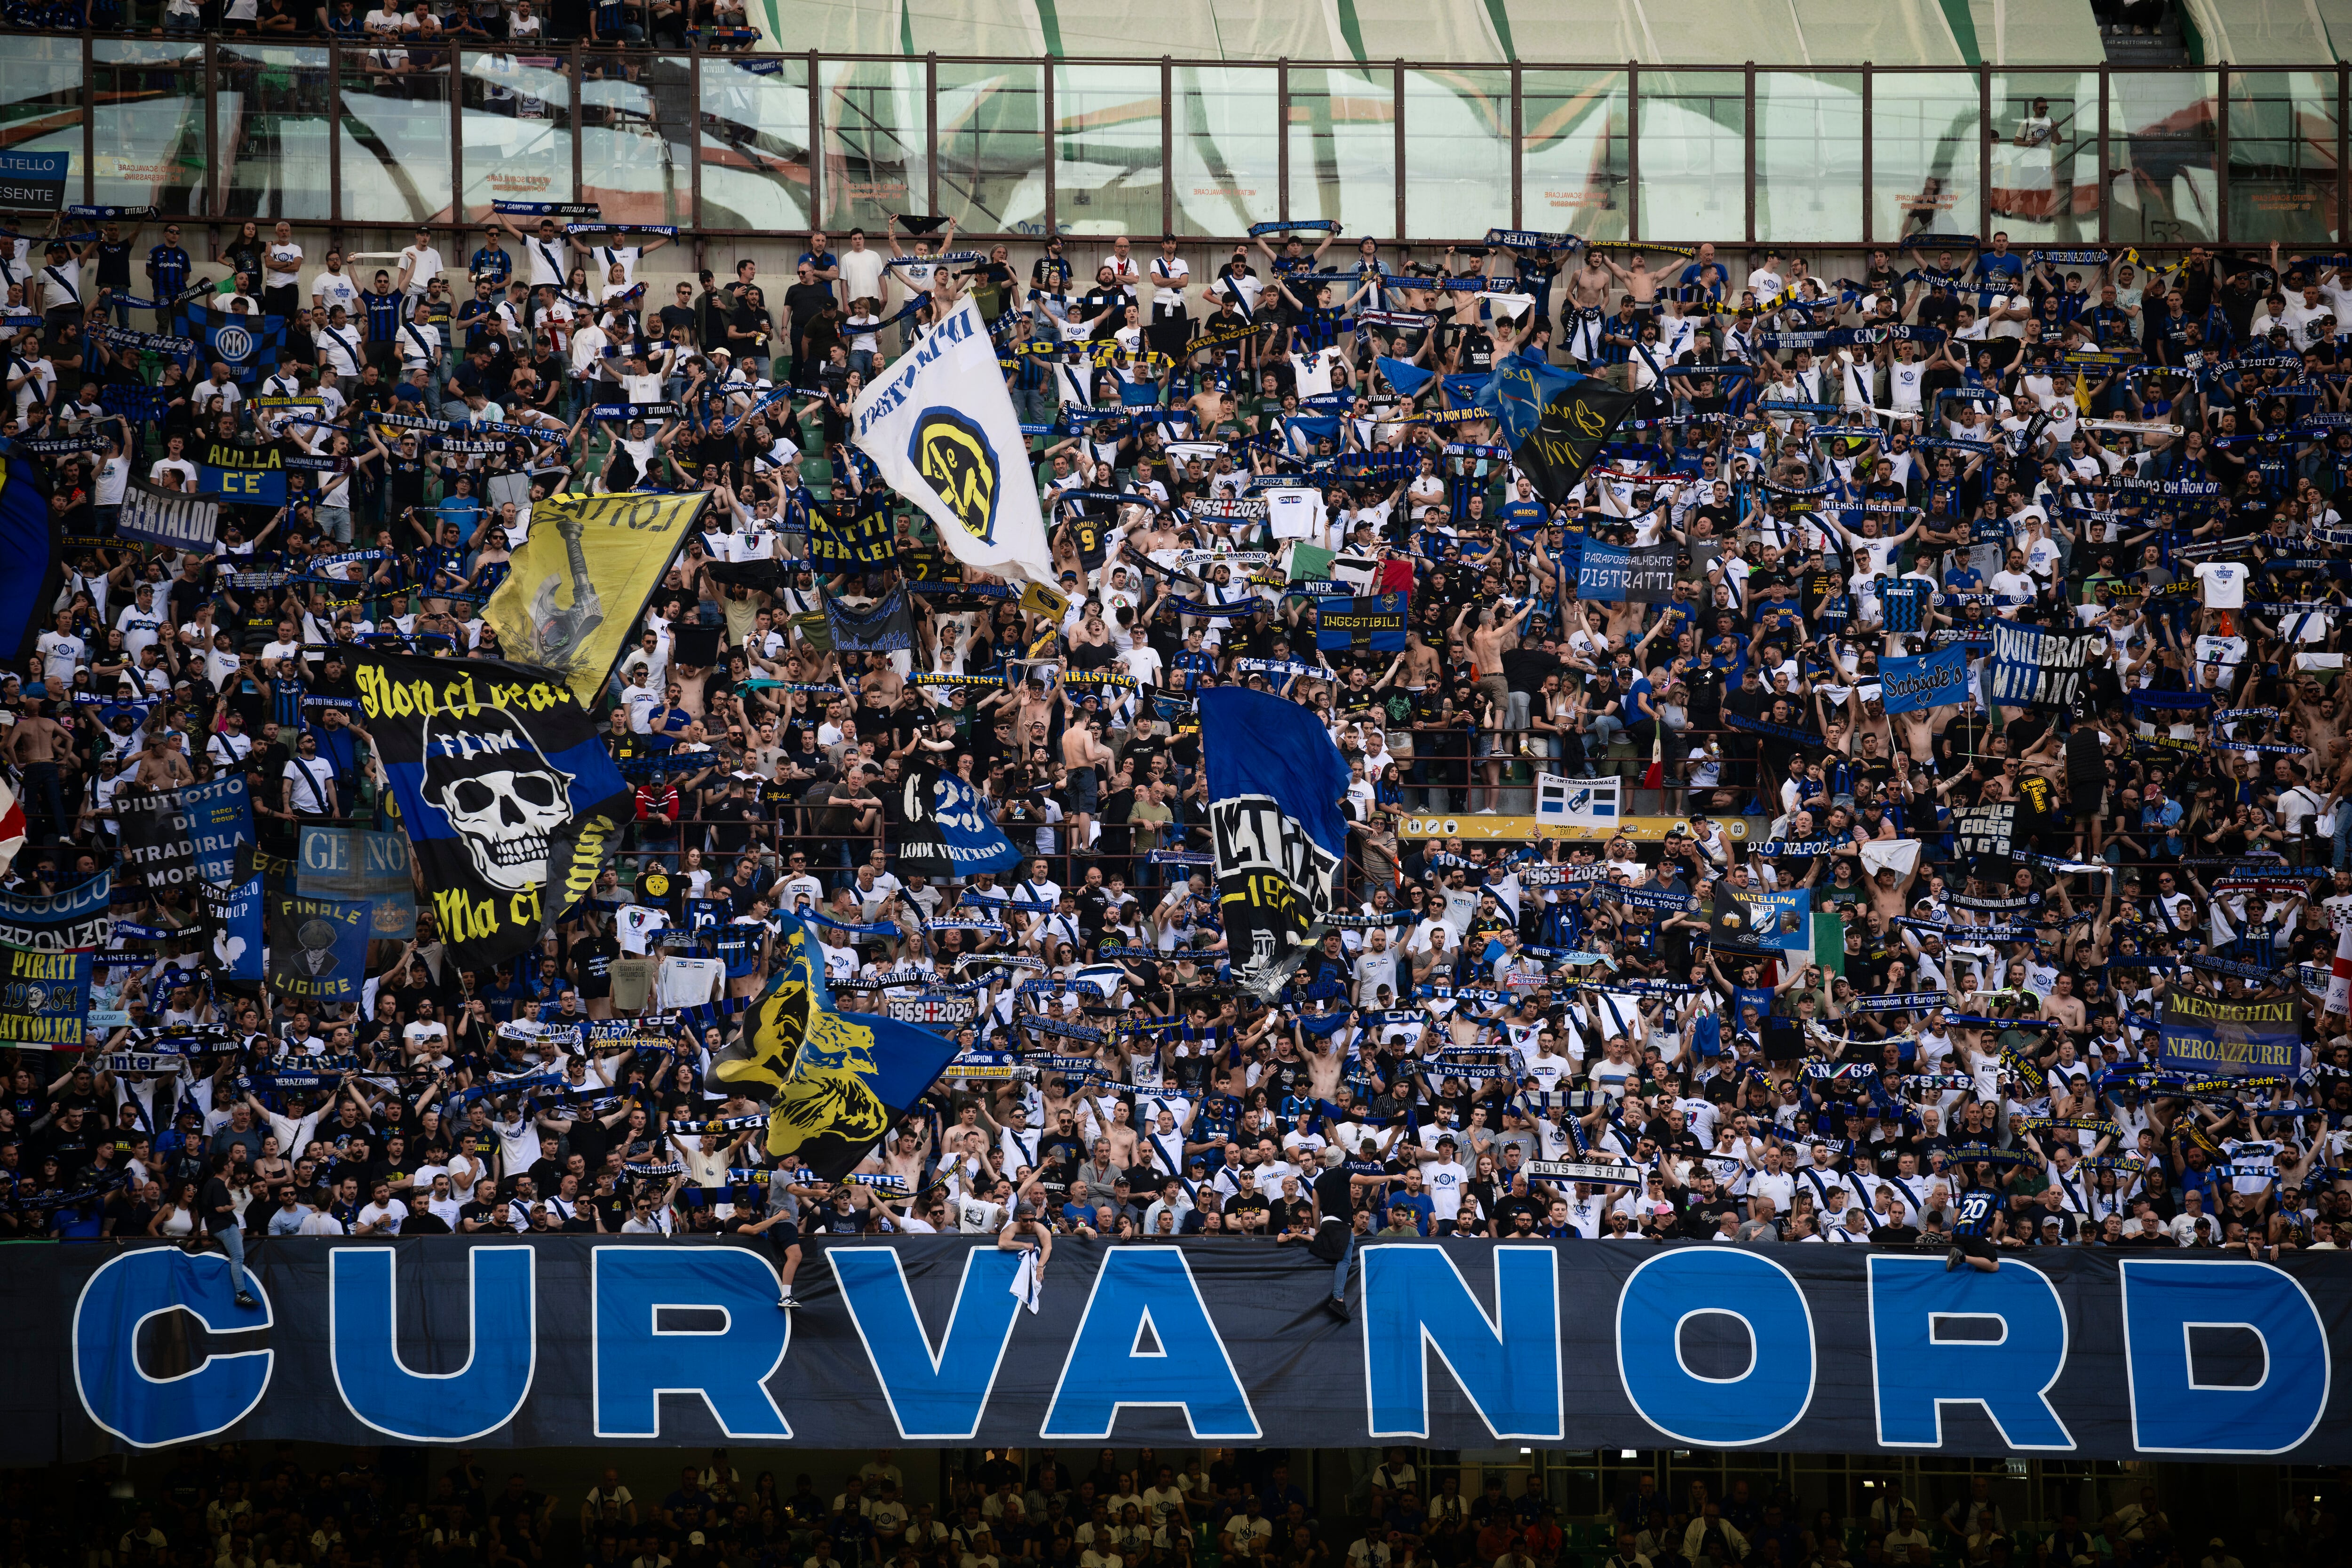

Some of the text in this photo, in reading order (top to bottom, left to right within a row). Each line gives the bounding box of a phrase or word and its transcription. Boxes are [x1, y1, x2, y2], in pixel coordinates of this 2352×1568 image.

[71, 206, 149, 215] CAMPIONI D'ITALIA
[1253, 221, 1329, 233] CURVA NORD
[1387, 277, 1482, 290] CURVA NORD
[1220, 325, 1260, 341] NORD
[1854, 327, 1910, 343] CN 69
[261, 398, 282, 406] ESSERCI
[649, 405, 672, 414] D'ITALIA
[383, 414, 449, 430] MILANO
[1445, 412, 1461, 421] NON
[485, 422, 564, 442] FORZA INTER
[443, 439, 506, 452] MILANO
[208, 444, 282, 468] AULLA
[1757, 475, 1827, 494] FORZA INTER
[2164, 481, 2204, 494] NON HO
[1234, 502, 1266, 517] 2024
[1821, 501, 1905, 512] INTERISTI TRENTINI
[120, 486, 219, 542] CERTALDO
[2090, 512, 2118, 523] INTER
[1074, 521, 1098, 532] RONALDO
[79, 538, 125, 548] PER GLI
[1081, 530, 1094, 552] 9
[813, 538, 894, 563] PER LEI
[311, 556, 338, 567] FIGHT
[366, 550, 381, 559] US
[1181, 554, 1212, 563] MILANO
[1585, 552, 1673, 566] PARADOSSALMENTE
[1580, 568, 1673, 591] DISTRATTI
[908, 581, 1008, 597] CURVA NORD
[1305, 582, 1332, 592] INTER
[2264, 604, 2340, 617] MILANO
[1323, 616, 1400, 627] INGESTIBILI
[1252, 658, 1292, 669] Magica
[917, 673, 1003, 686] IMBASTISCI
[1884, 661, 1963, 696] Satriale's
[1993, 664, 2079, 703] MILANO
[357, 664, 479, 718] Non ci
[2137, 733, 2202, 755] never drink alone
[2228, 741, 2259, 751] FIGHT
[2266, 744, 2287, 753] FOR
[118, 779, 244, 812] PIUTTOSTO
[767, 792, 792, 802] Diffidati
[211, 807, 232, 816] BARGI
[173, 814, 196, 830] DI
[212, 815, 235, 824] GROUP
[132, 832, 244, 863] TRADIRLA
[899, 842, 1007, 862] LODI VECCHIO
[148, 860, 234, 888] MORIRE
[1525, 865, 1607, 884] 1969 2024
[2233, 867, 2291, 877] MILANO
[1665, 892, 1685, 900] FIGLIO
[1733, 893, 1796, 906] VALTELLINA
[1960, 895, 2026, 907] INTERNAZIONALE MILANO
[1634, 898, 1683, 910] DAL 1908
[209, 904, 248, 918] GROUP
[282, 901, 361, 925] FINALE
[433, 888, 500, 944] Ma
[1327, 914, 1393, 925] MILANO
[118, 923, 146, 936] CAMPIONI
[1100, 945, 1225, 958] CURVA NORD
[1532, 947, 1550, 956] INTER
[12, 951, 76, 979] PIRATI
[275, 977, 351, 995] LIGURE
[5, 982, 77, 1011] 19 84
[1438, 986, 1498, 1000] TI AMO
[1867, 995, 1941, 1008] campioni Europa
[2171, 993, 2293, 1022] MENEGHINI
[890, 1003, 972, 1022] 1969 2024
[1384, 1010, 1424, 1021] CN
[504, 1029, 536, 1039] MILANO
[213, 1041, 239, 1051] D'ITALIA
[2167, 1036, 2293, 1066] NEROAZZURRI
[965, 1054, 992, 1063] CAMPIONI
[1053, 1058, 1091, 1067] INTER
[950, 1066, 1011, 1076] DI MILANO
[1445, 1066, 1495, 1077] DAL 1908
[1809, 1062, 1873, 1078] CN 69
[276, 1078, 319, 1087] NERAZZURRI
[1105, 1082, 1182, 1096] FIGHT FOR US
[2197, 1077, 2273, 1090] BOYS SAN
[1534, 1162, 1626, 1178] BOYS SAN
[2241, 1166, 2279, 1177] AMO
[1959, 1199, 1985, 1219] 20
[72, 1244, 2331, 1454] CURVA NORD
